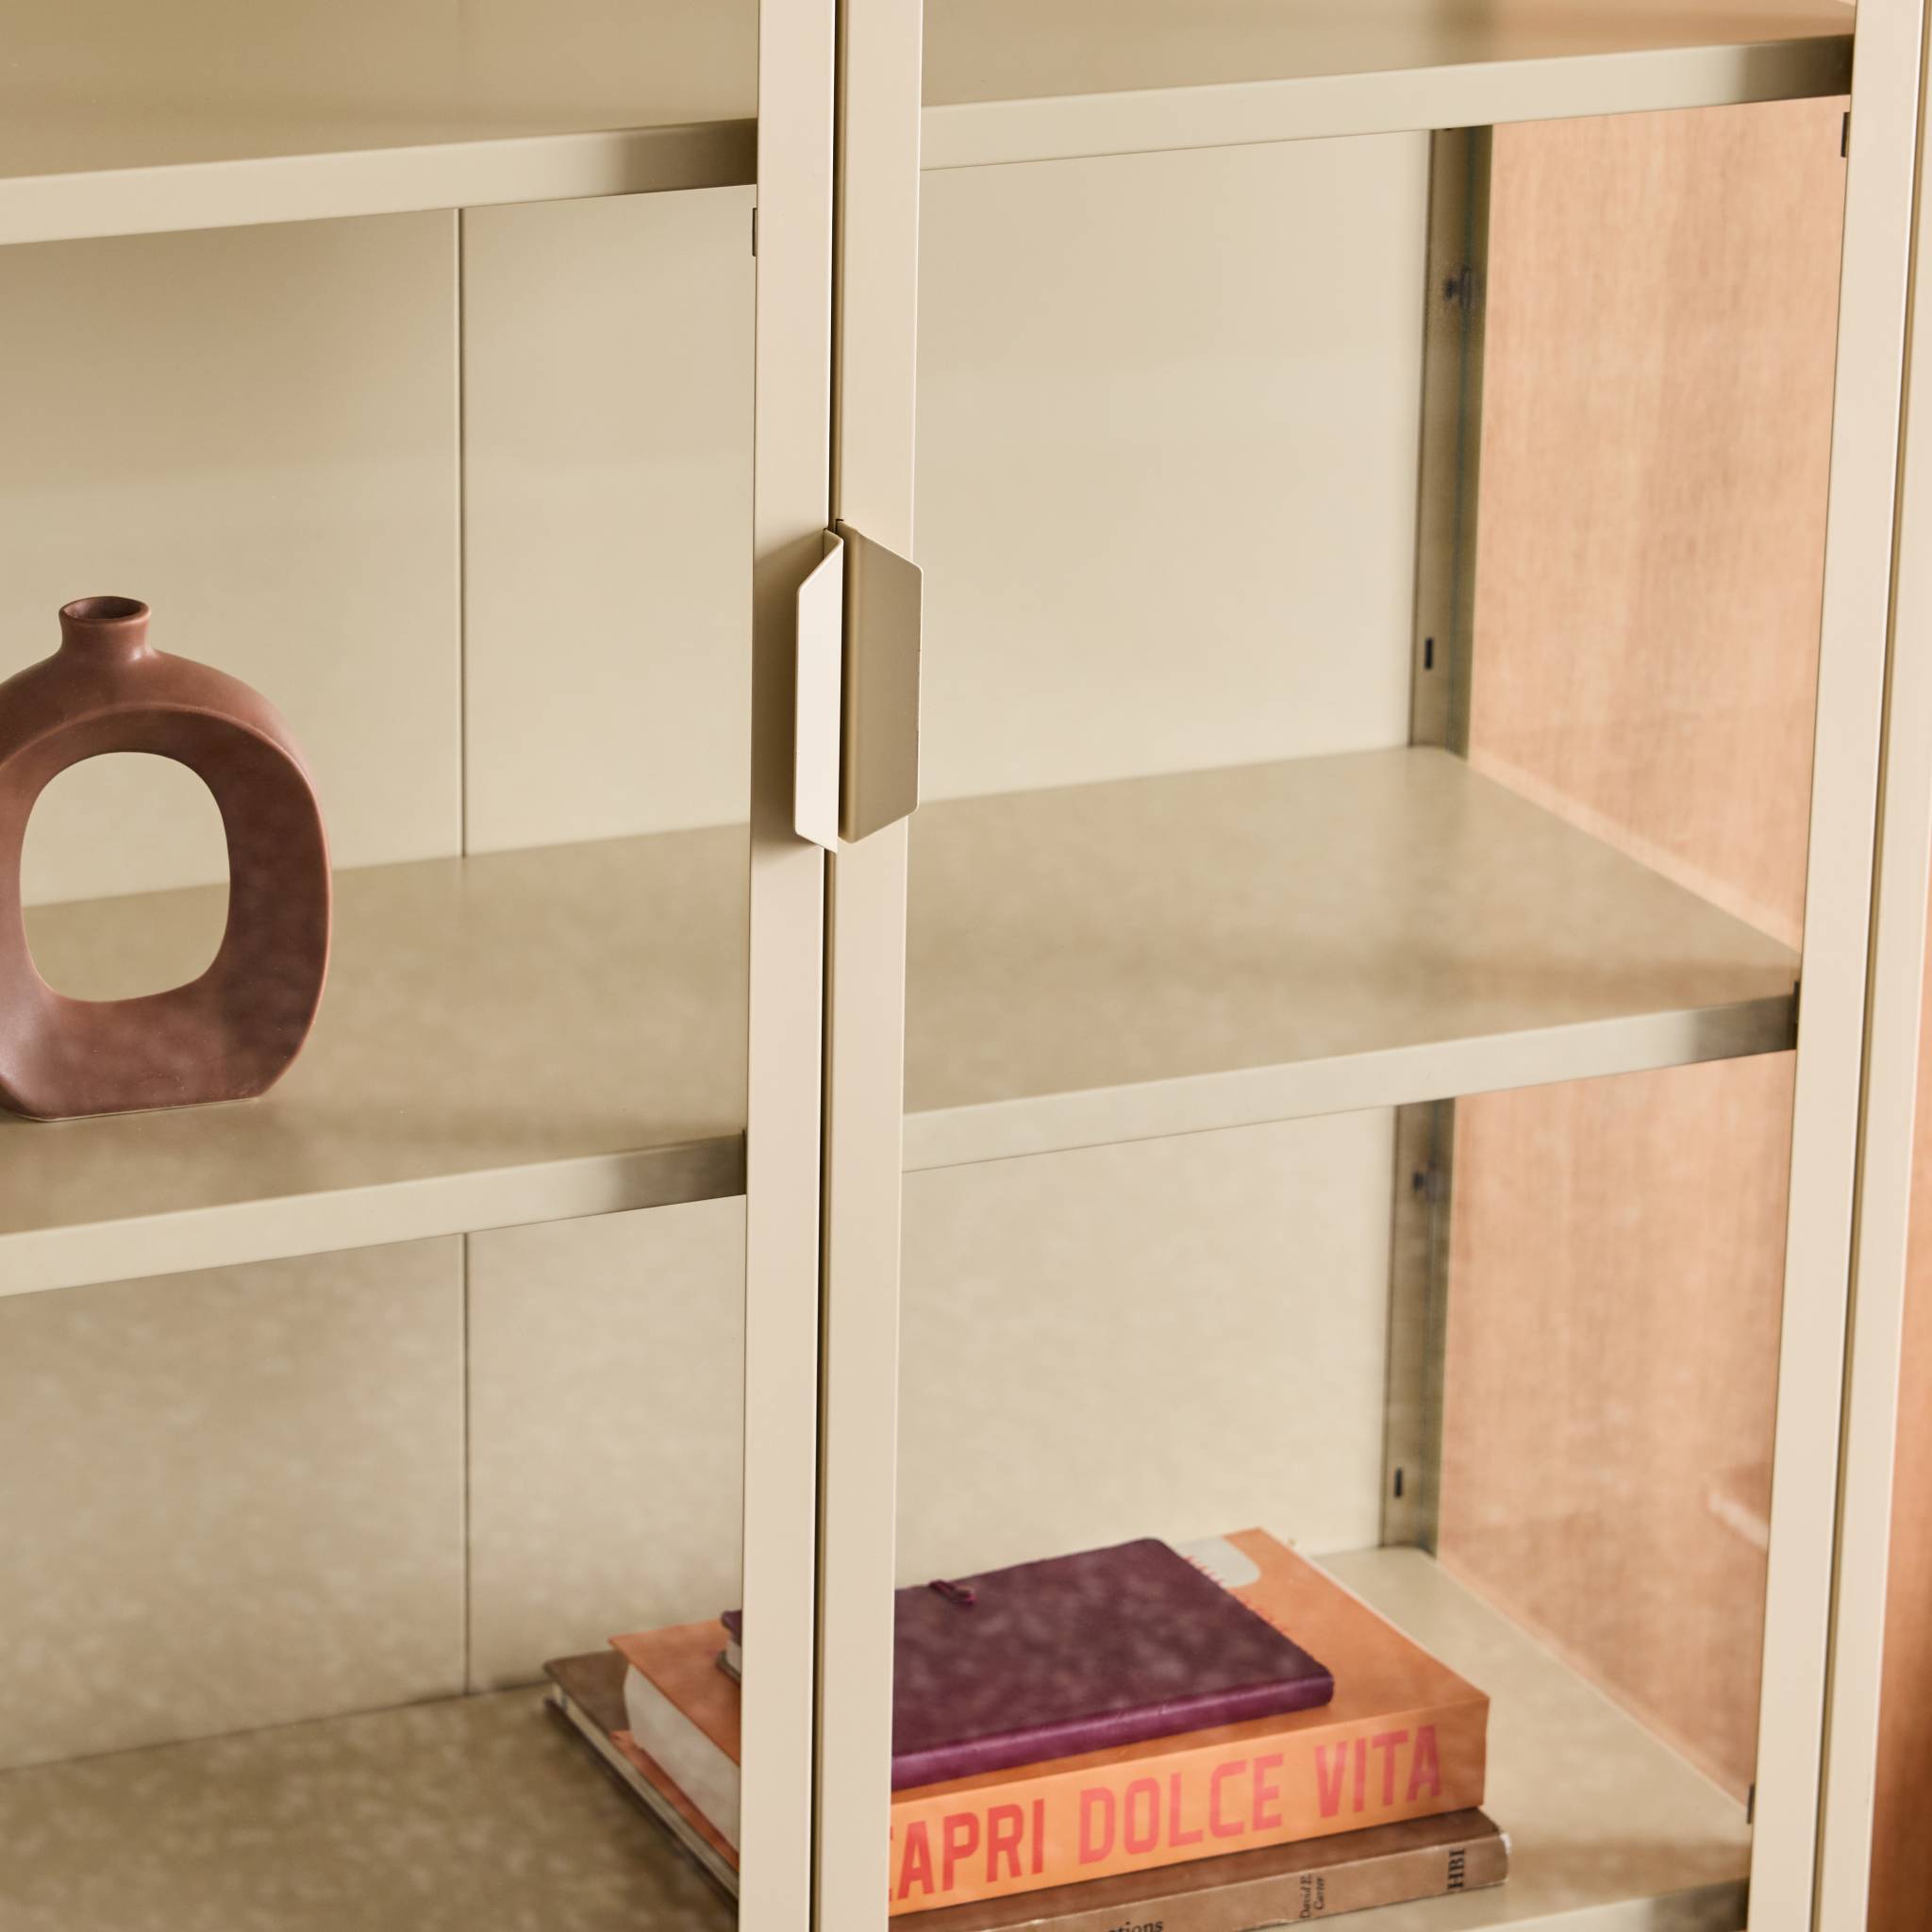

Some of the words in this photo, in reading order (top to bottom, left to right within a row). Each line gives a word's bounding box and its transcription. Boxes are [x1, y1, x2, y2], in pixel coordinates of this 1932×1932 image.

[889, 1798, 1045, 1902] APRI
[1078, 1754, 1284, 1865] DOLCE
[1314, 1724, 1442, 1819] VITA
